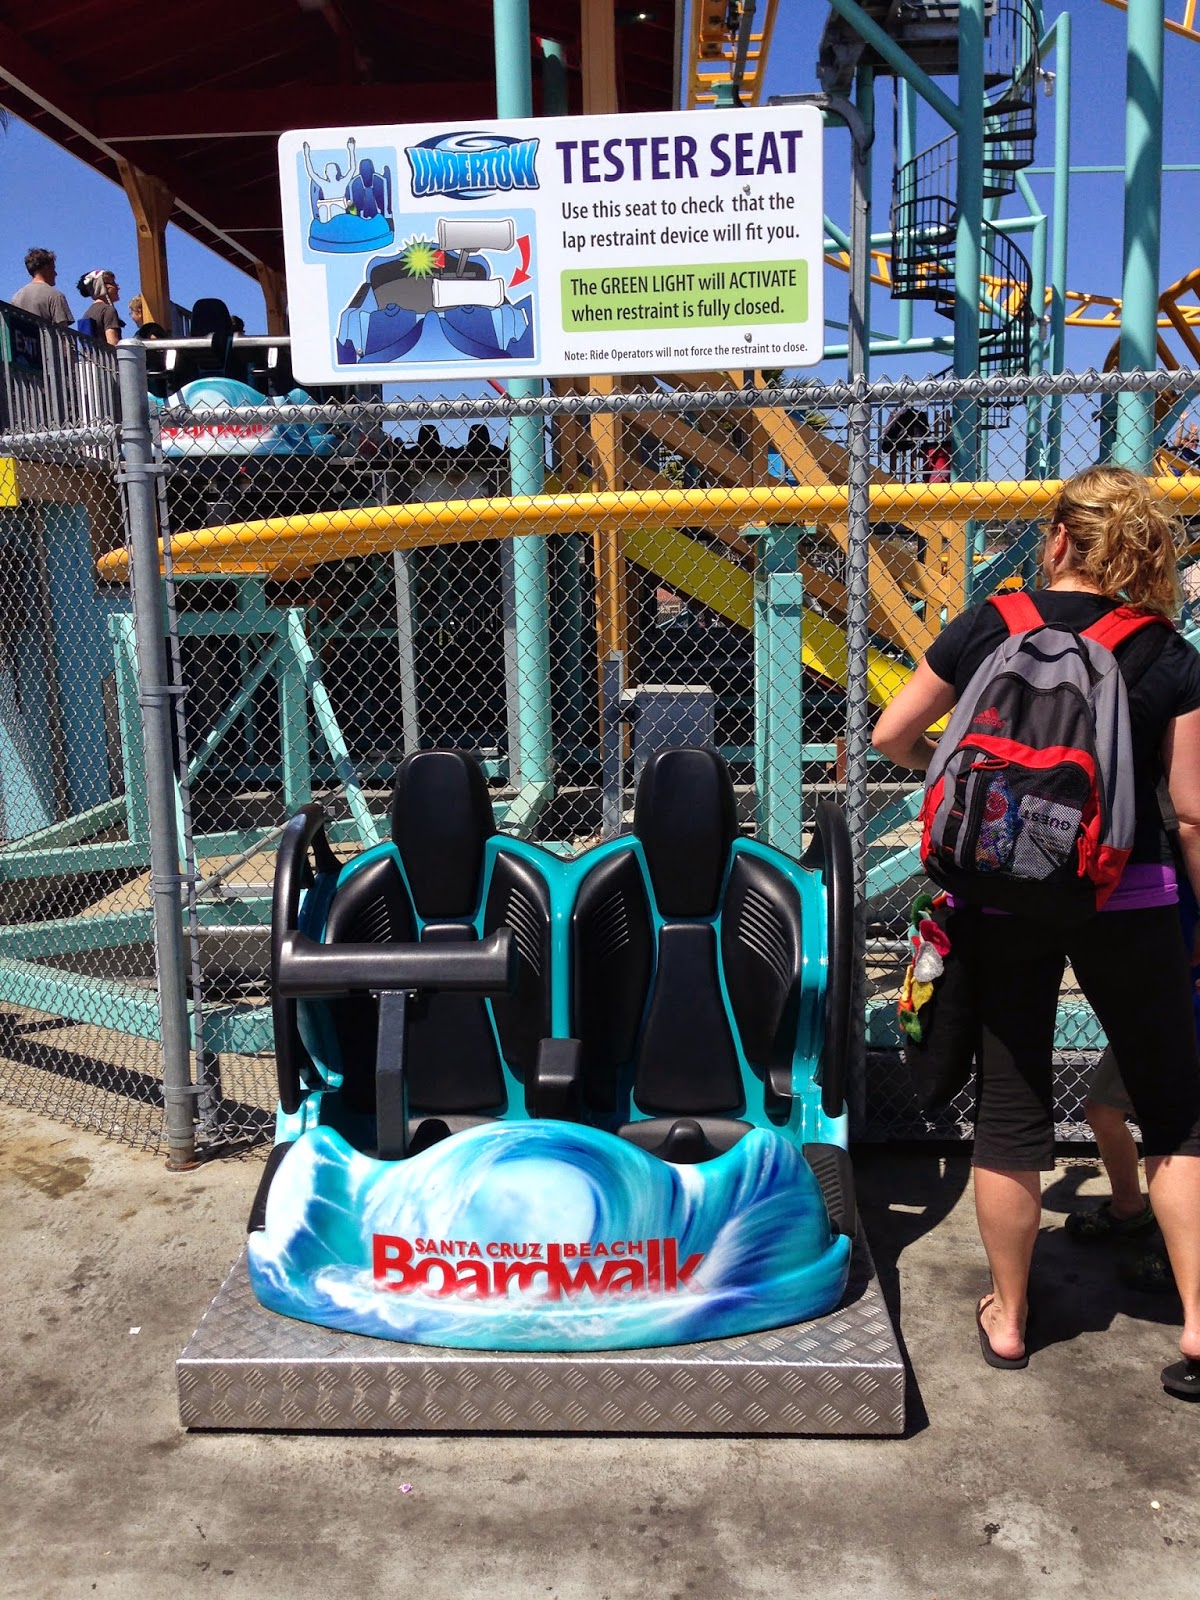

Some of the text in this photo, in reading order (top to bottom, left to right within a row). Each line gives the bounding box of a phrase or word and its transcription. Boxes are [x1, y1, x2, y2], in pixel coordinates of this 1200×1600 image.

[404, 138, 540, 198] UNDERTOW
[556, 130, 803, 184] TESTER SEAT
[562, 192, 795, 219] Use this seat to check that the
[563, 222, 800, 252] lap restraint device will fit you.
[571, 269, 797, 296] The GREEN LIGHT will ACTIVATE
[572, 296, 784, 322] when restraint is fully closed.
[564, 342, 808, 362] Note: Ride Operators will not force the restraint to close.
[1020, 810, 1071, 831] GUEST
[415, 1237, 644, 1259] SANTA CRUZ BEACH
[372, 1233, 706, 1301] Boardwalk
